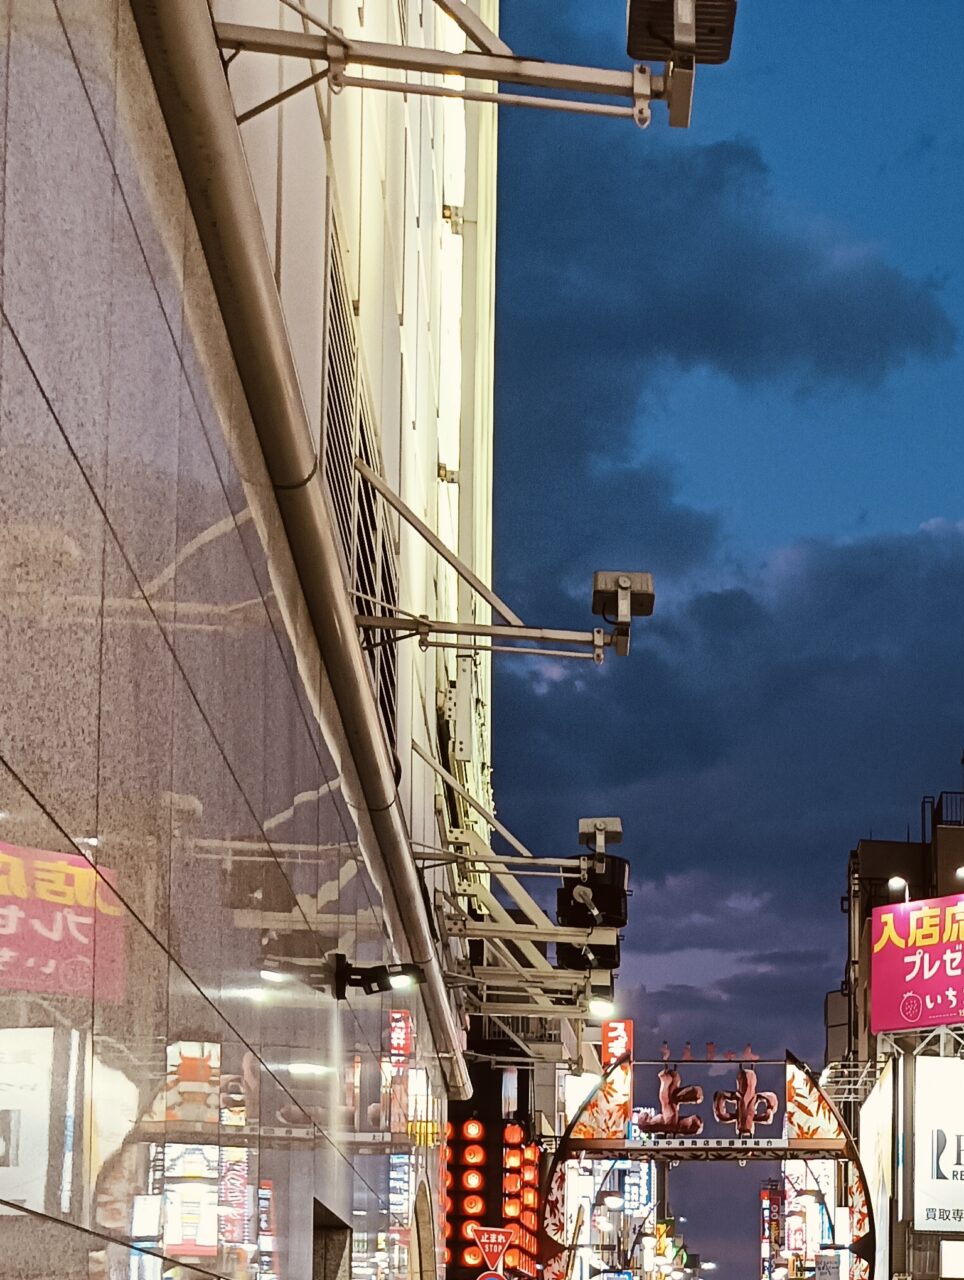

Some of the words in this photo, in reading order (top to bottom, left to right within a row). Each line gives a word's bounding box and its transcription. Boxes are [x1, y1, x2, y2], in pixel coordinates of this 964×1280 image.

[480, 1233, 506, 1243] 止まれ
[484, 1244, 503, 1253] STOP
